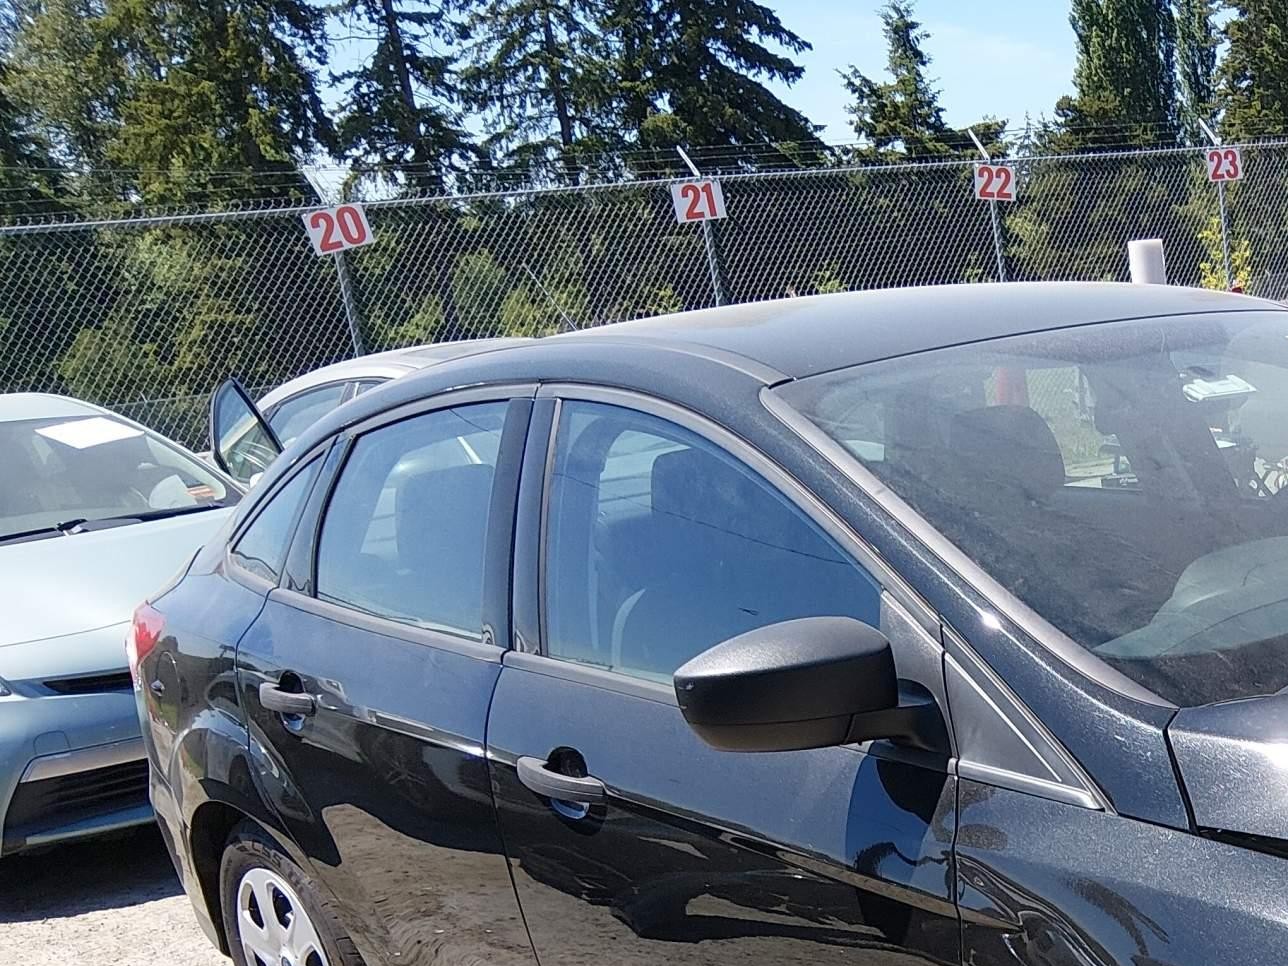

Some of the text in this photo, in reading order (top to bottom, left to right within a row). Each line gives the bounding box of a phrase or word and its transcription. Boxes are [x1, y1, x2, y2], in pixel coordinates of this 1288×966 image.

[1209, 149, 1239, 180] 23
[978, 166, 1012, 199] 22
[681, 182, 718, 220] 21
[310, 205, 367, 252] 20
